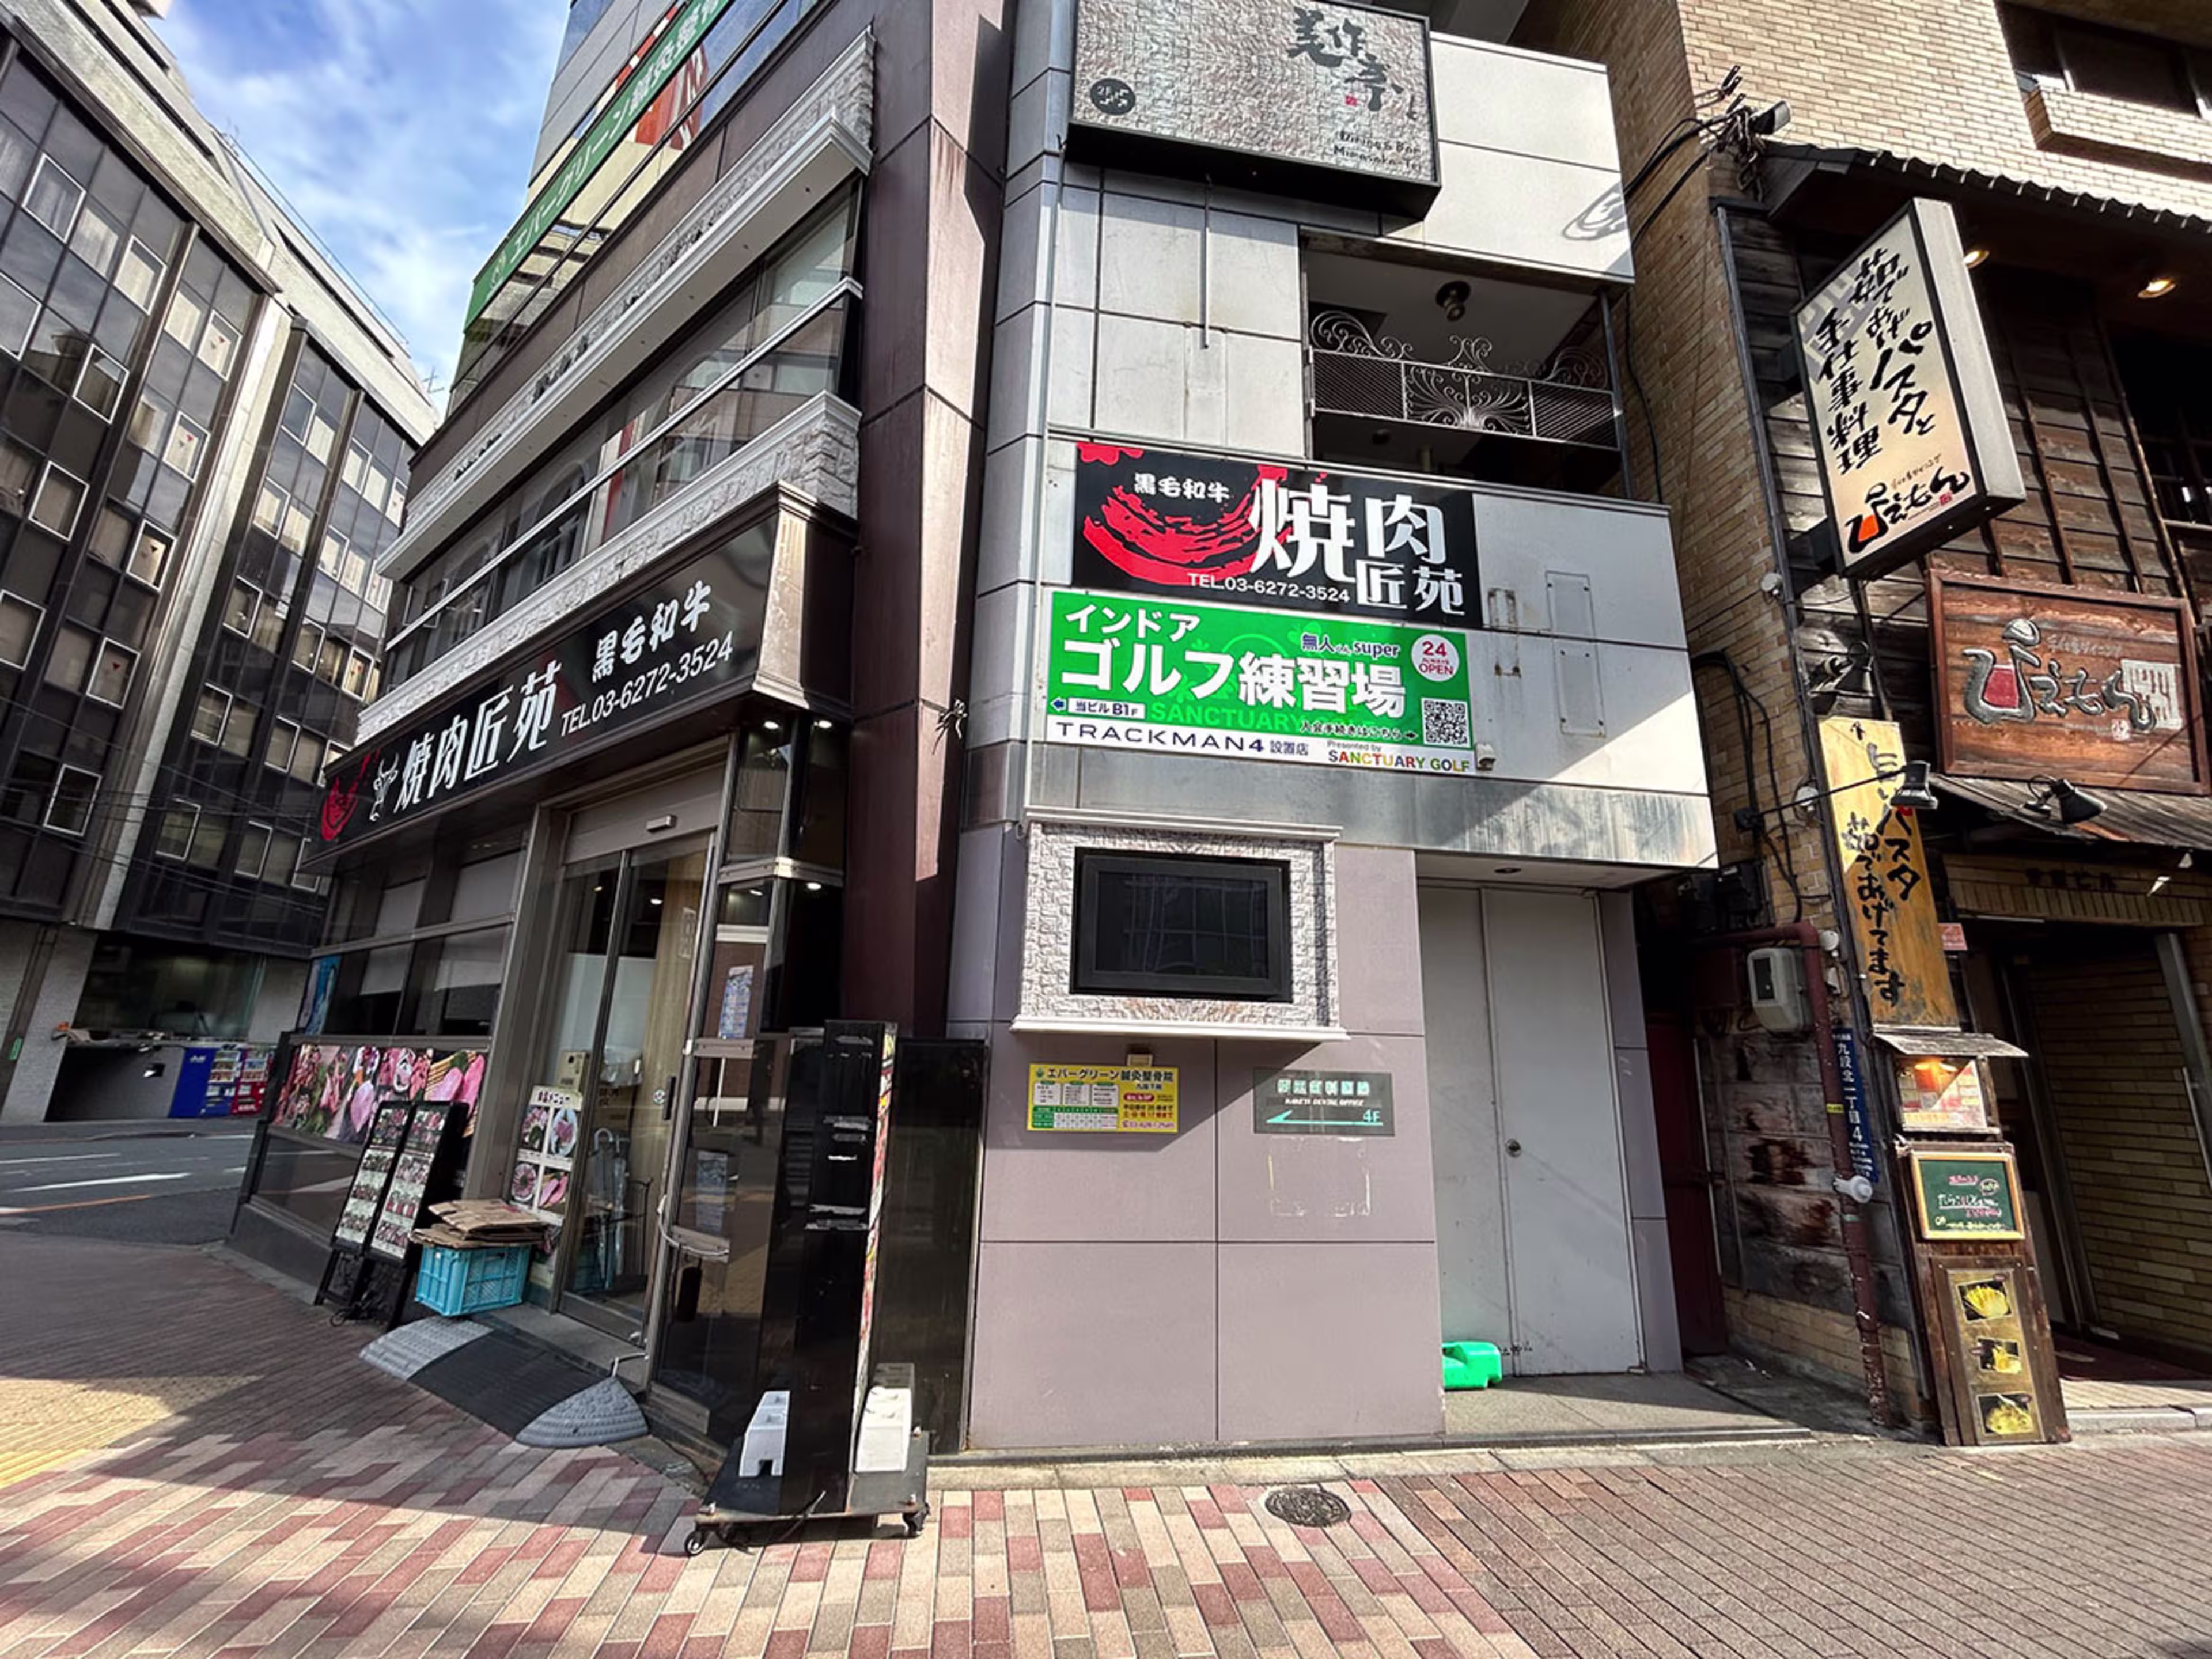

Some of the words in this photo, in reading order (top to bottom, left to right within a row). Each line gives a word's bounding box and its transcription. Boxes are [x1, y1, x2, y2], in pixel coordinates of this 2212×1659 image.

[1816, 307, 1883, 476] 手仕事料理
[1134, 472, 1230, 503] 黒毛和牛
[1248, 478, 1447, 583] 焼肉
[1187, 573, 1350, 603] TEL.03-6272-3524
[1355, 559, 1465, 616] 匠苑
[592, 580, 711, 683] 黒毛和牛
[1065, 604, 1201, 642] インドア
[1353, 642, 1399, 659] super
[1422, 641, 1448, 657] 24
[560, 631, 733, 737] TEL.03-6272-3524
[1061, 637, 1406, 719] ゴルフ練習場
[1418, 664, 1454, 676] OPEN
[393, 660, 563, 814] 焼肉匠苑
[1270, 740, 1309, 756] 設置店
[1328, 750, 1425, 770] SANCTUARY
[1430, 760, 1470, 772] GOLF
[1363, 1109, 1381, 1123] 4F
